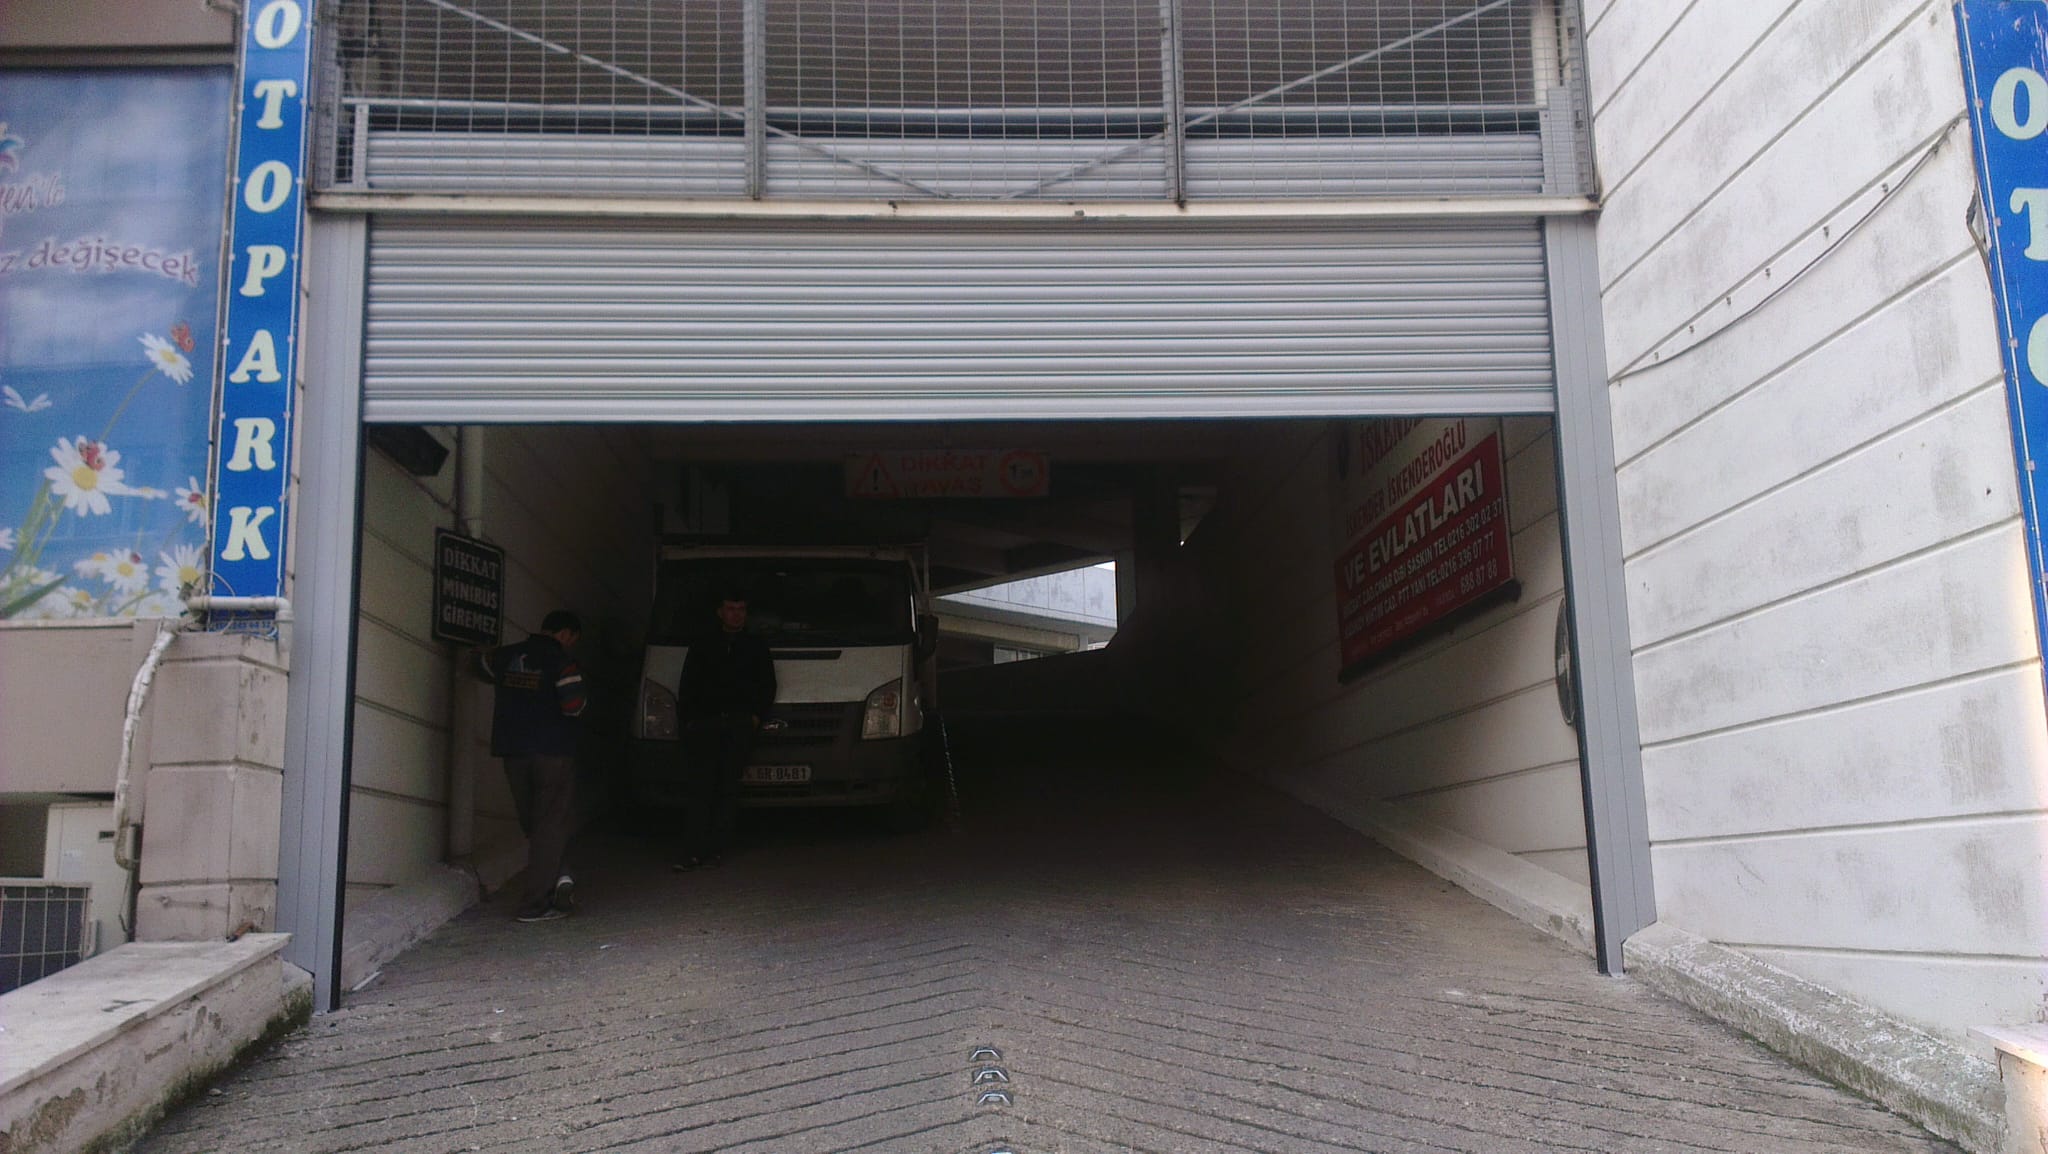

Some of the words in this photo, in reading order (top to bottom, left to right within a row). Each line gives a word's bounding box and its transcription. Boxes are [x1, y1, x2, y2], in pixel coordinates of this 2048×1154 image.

[28, 239, 197, 284] değişecek
[221, 0, 301, 562] OTOPARK
[1387, 419, 1466, 507] İSKENDEROĞLU
[1343, 551, 1365, 592] VE
[1368, 458, 1483, 575] EVLATLARI
[444, 546, 497, 581] DİKKAT
[442, 600, 497, 635] GİREMEZ
